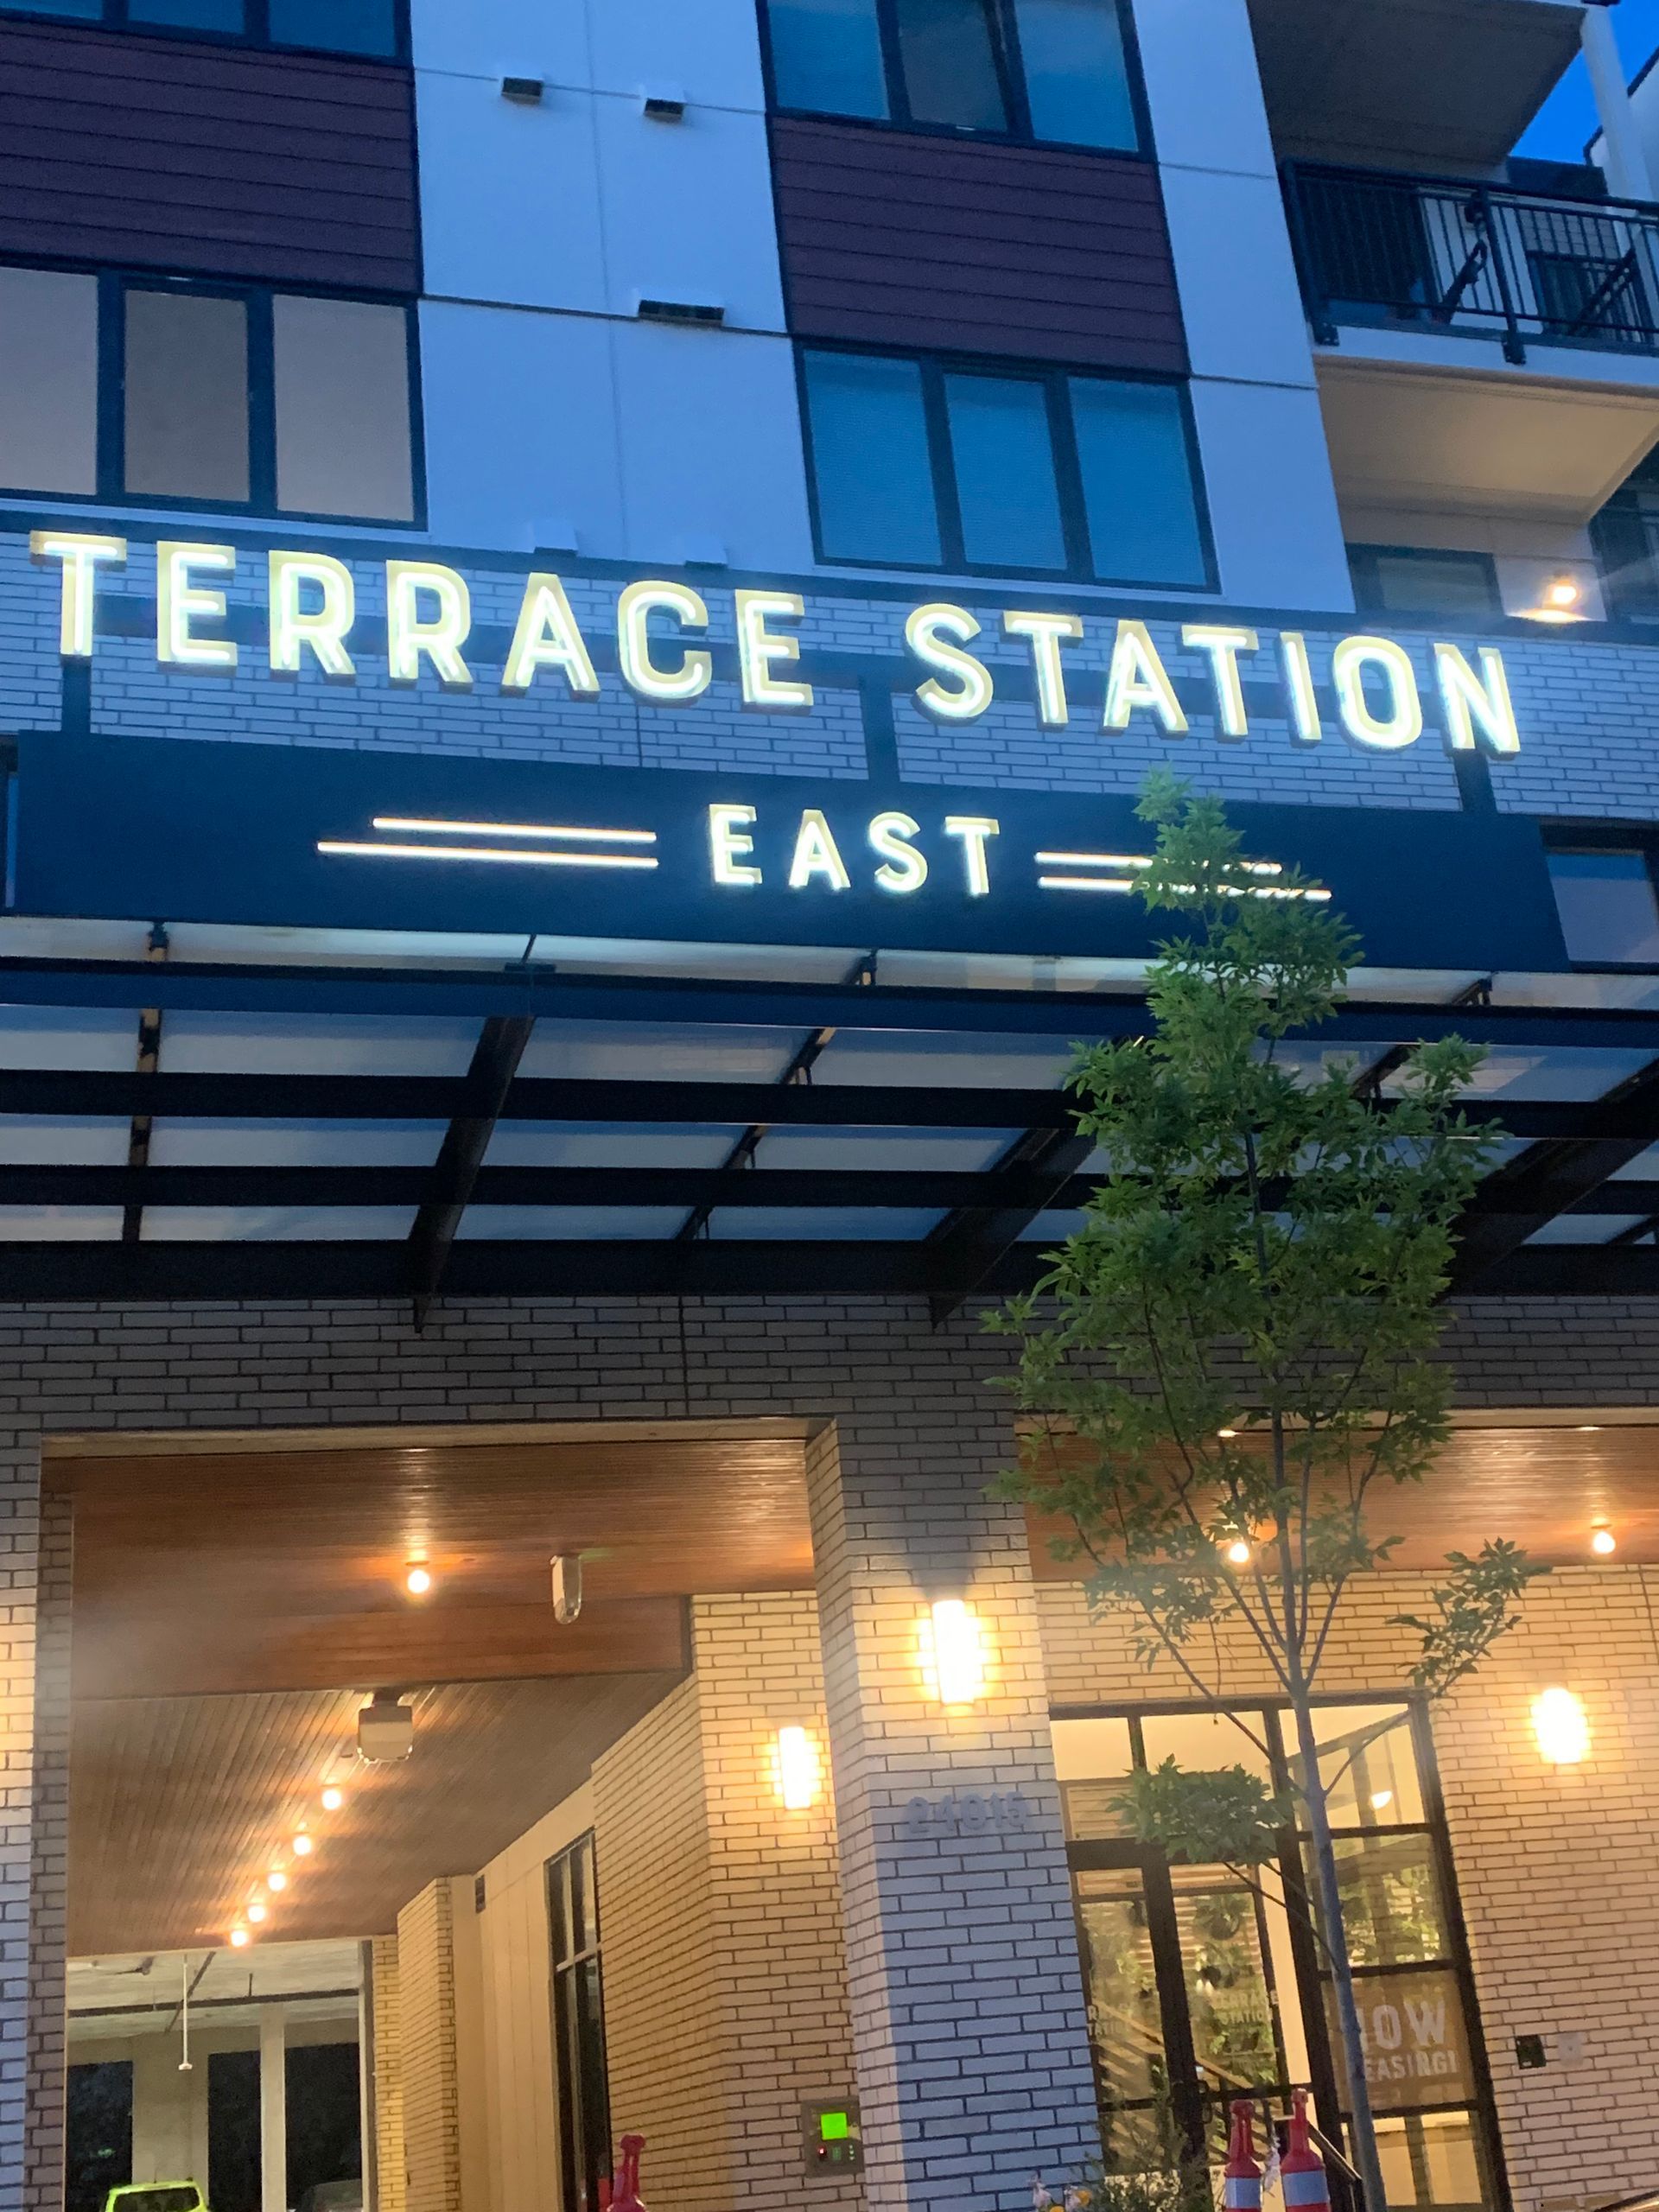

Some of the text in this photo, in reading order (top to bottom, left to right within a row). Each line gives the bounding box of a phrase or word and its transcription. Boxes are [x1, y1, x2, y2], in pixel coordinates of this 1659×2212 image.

[29, 530, 1522, 758] TERRACE STATION
[707, 803, 1001, 896] EAST
[1363, 2050, 1459, 2083] EASING!
